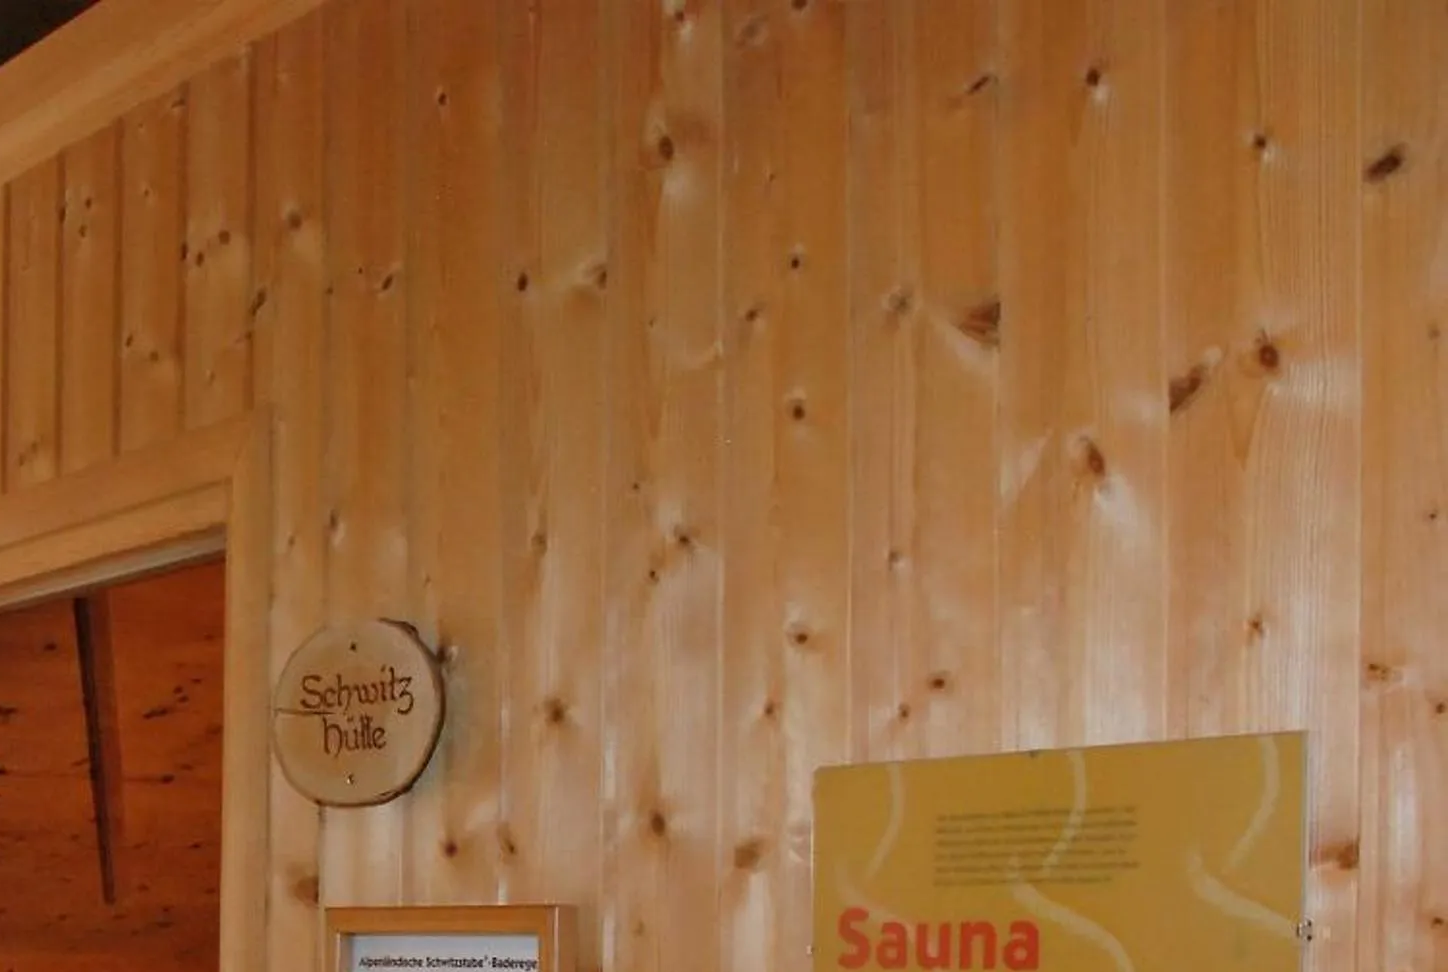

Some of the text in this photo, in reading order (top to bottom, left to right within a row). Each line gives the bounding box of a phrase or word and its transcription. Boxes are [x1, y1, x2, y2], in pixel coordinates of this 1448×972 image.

[300, 665, 414, 715] Schwitz
[323, 713, 386, 758] hütte
[838, 907, 1039, 971] Sauna
